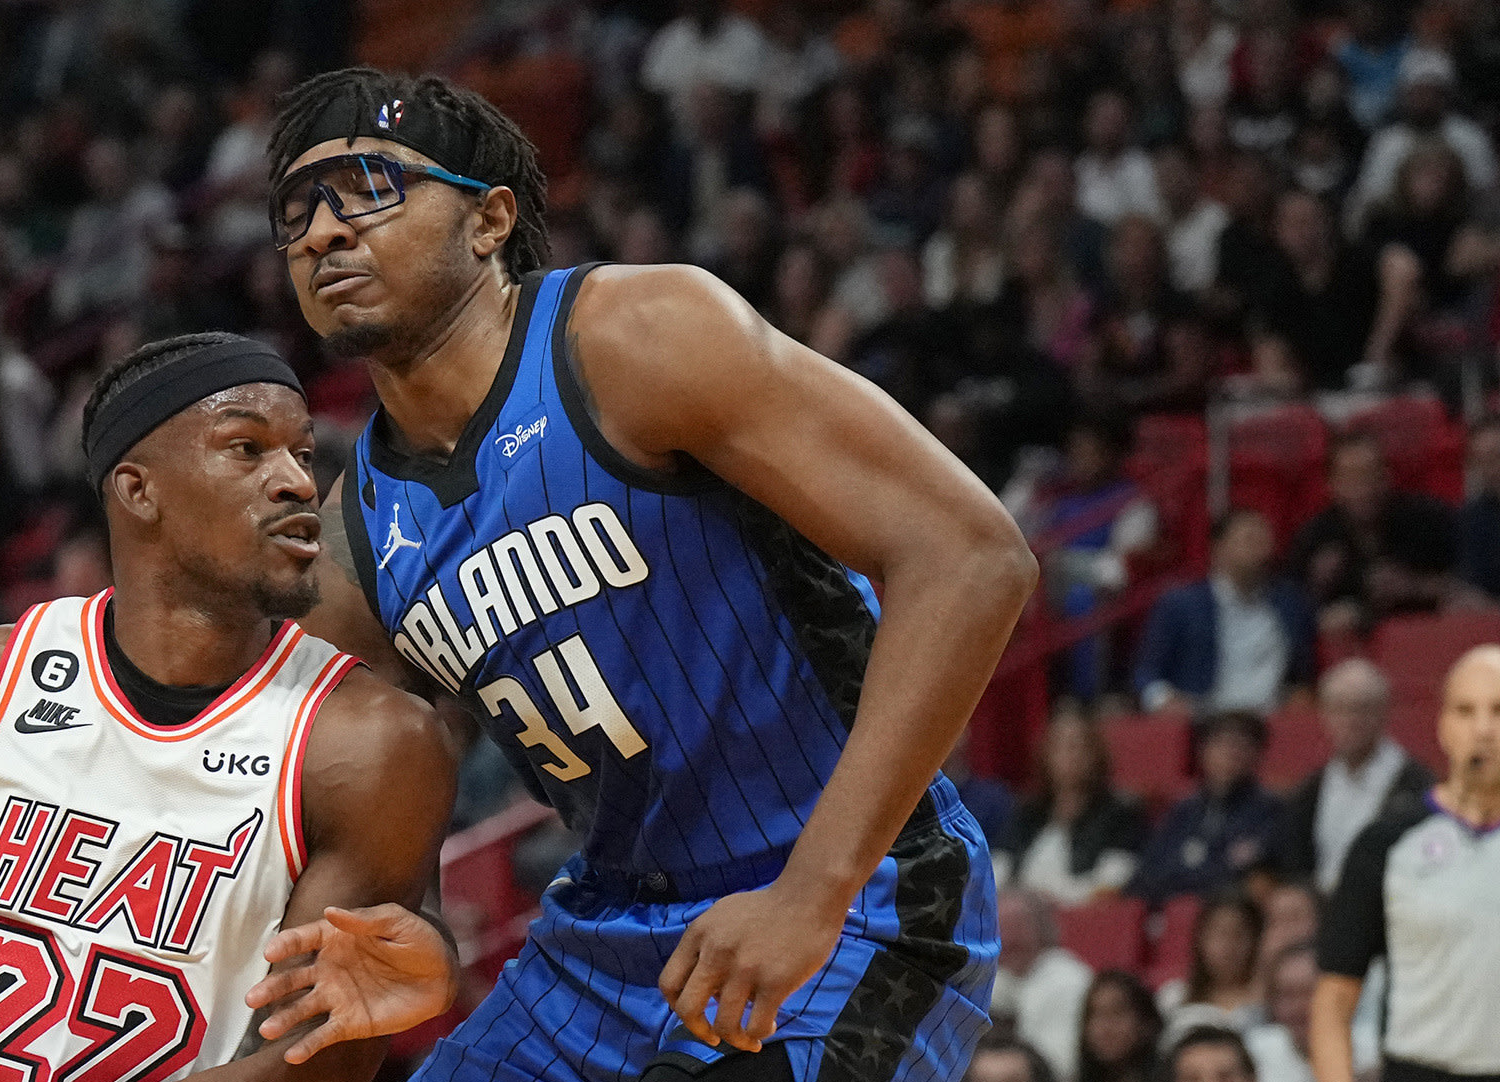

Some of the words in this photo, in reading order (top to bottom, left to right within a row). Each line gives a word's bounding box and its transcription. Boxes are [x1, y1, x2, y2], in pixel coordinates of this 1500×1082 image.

[393, 501, 649, 698] ORLANDO
[27, 698, 81, 728] NIKE
[39, 655, 72, 689] 6
[477, 630, 649, 783] 34
